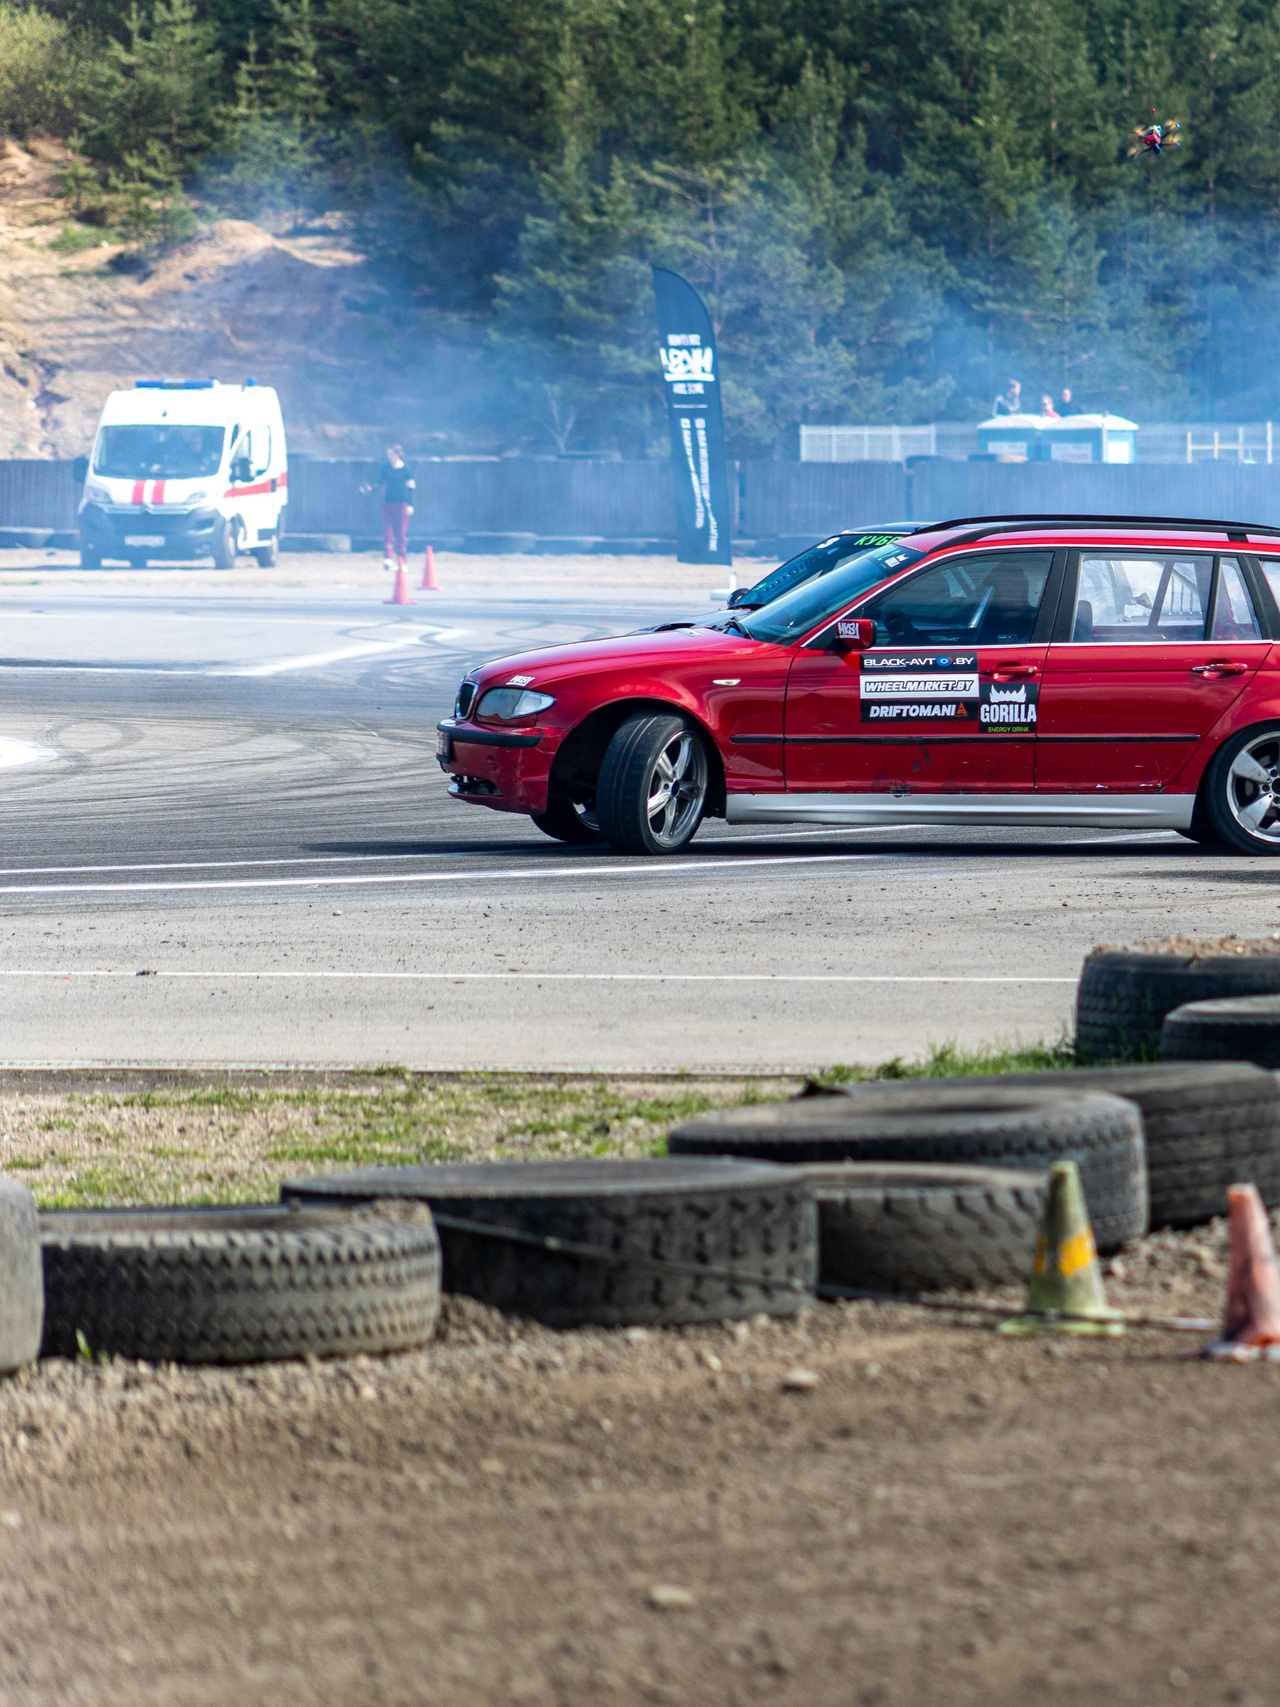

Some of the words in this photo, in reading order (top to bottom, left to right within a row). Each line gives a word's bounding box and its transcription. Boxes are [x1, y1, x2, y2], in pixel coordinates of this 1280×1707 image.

[865, 680, 974, 692] WHEELMARKET.BY
[869, 702, 968, 718] DRIFTOMANIA
[980, 704, 1037, 723] GORILLA
